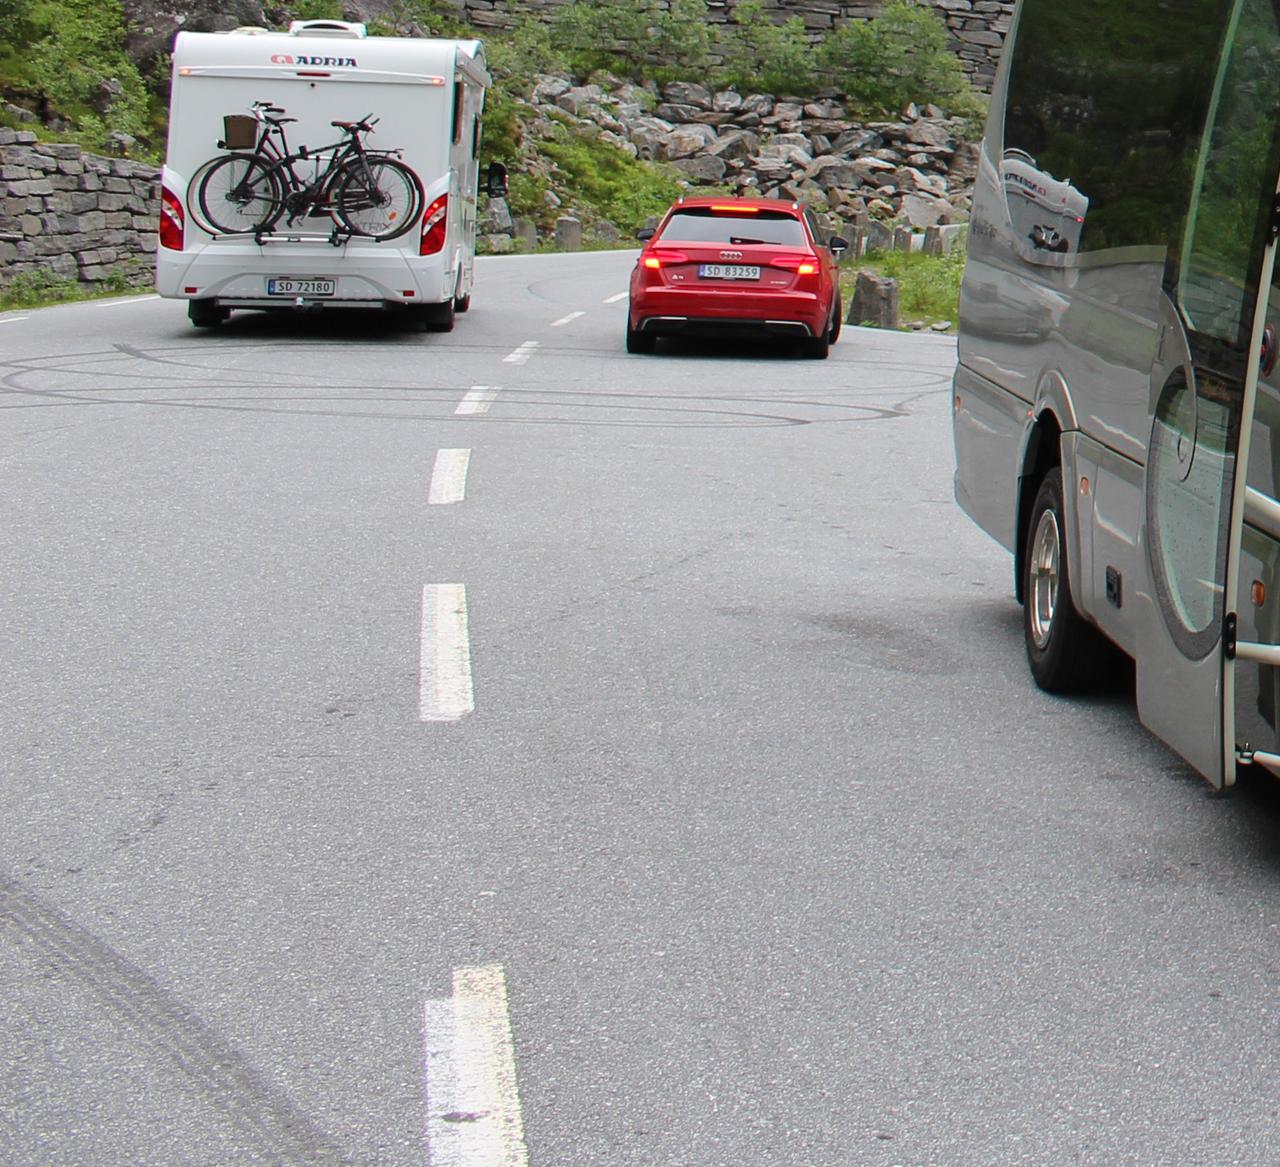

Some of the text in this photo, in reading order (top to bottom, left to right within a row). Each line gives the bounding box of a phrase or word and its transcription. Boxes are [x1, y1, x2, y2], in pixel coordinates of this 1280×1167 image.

[296, 55, 358, 67] ADRIA
[706, 265, 758, 277] SD 83259
[278, 281, 330, 293] SD 72180
